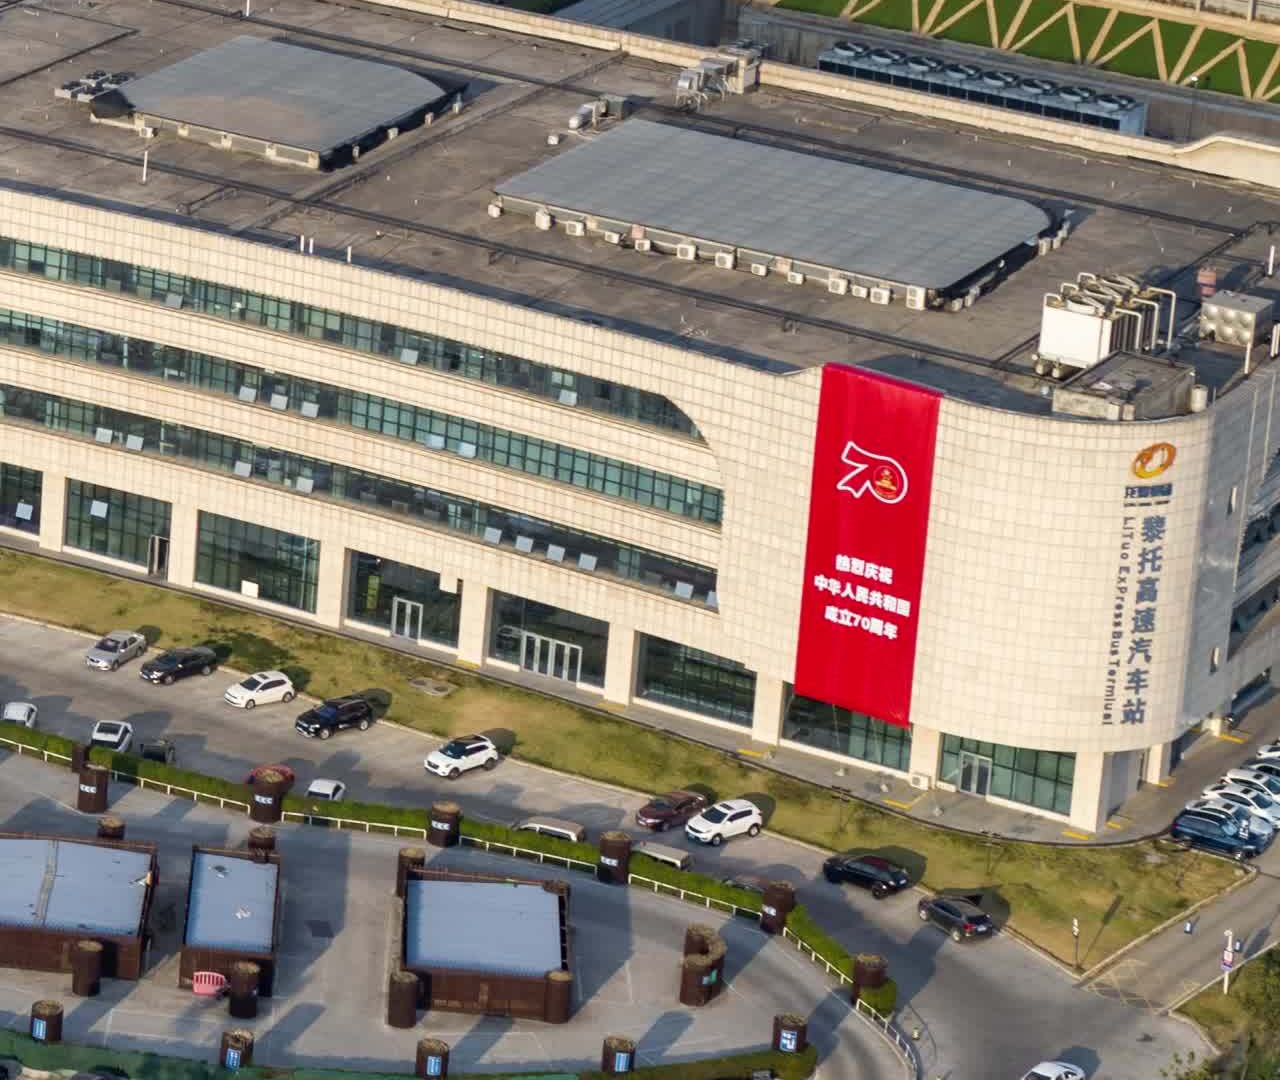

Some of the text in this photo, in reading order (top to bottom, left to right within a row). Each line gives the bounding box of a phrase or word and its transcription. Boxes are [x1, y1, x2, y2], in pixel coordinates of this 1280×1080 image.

[835, 553, 894, 585] 热烈庆祝
[814, 573, 912, 618] 中华人民共和国
[824, 604, 899, 640] 成立70周年
[1120, 514, 1167, 726] 黎托高速汽车站
